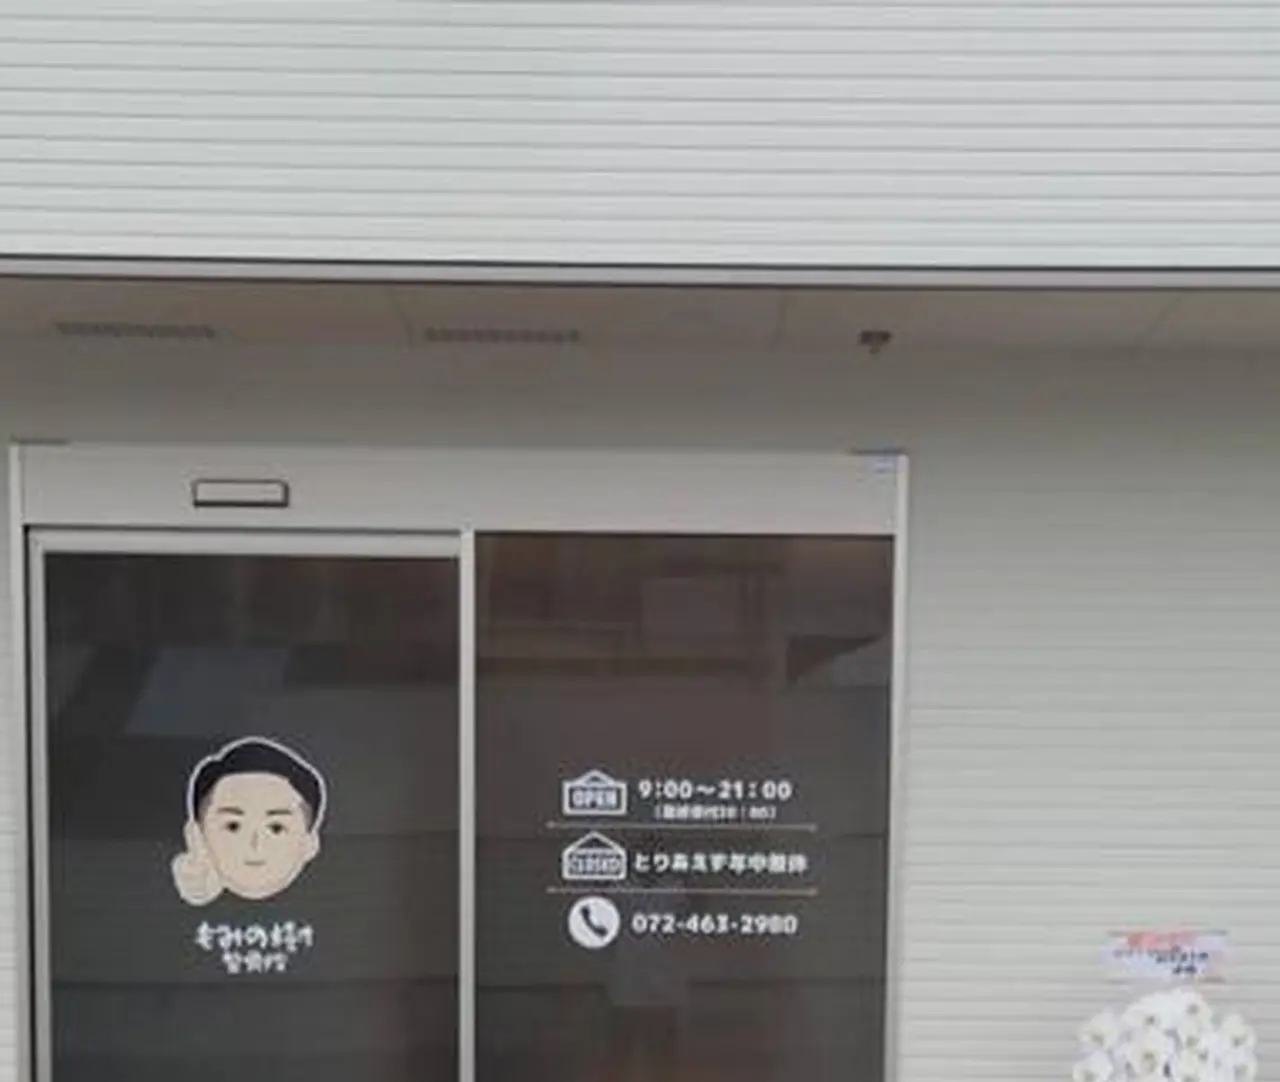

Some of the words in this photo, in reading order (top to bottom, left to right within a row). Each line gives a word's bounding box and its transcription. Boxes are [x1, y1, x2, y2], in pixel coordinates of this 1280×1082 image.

[572, 788, 617, 806] OPEN
[634, 853, 808, 874] とりあえず年中無休
